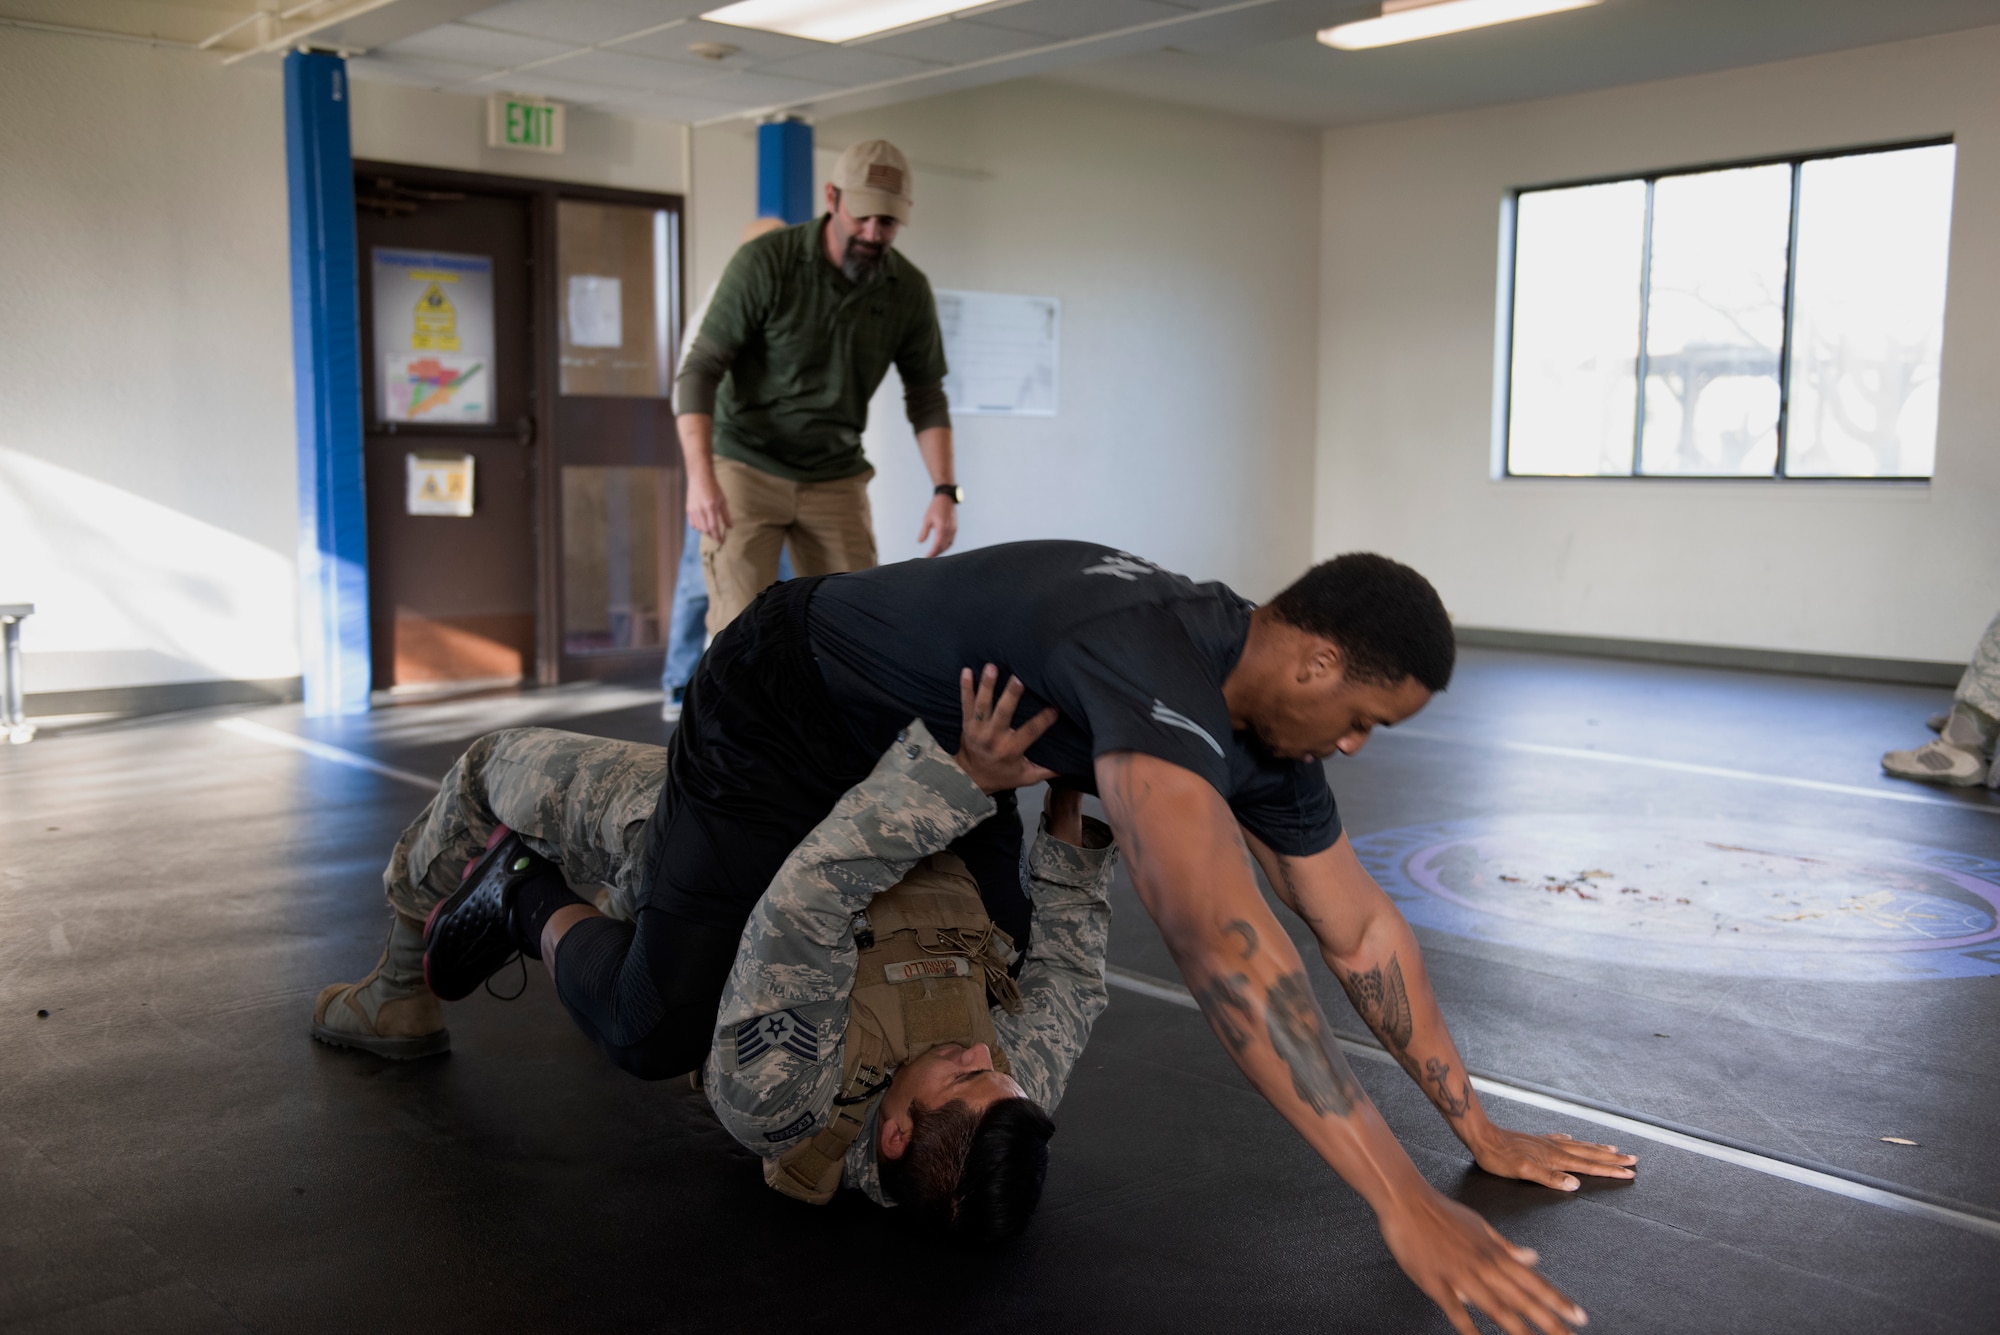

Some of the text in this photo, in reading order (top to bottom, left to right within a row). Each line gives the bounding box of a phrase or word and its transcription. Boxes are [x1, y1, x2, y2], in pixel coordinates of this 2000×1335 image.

[506, 102, 554, 147] EXIT
[903, 960, 957, 978] CARRILLO
[772, 1118, 810, 1140] RAVEN
